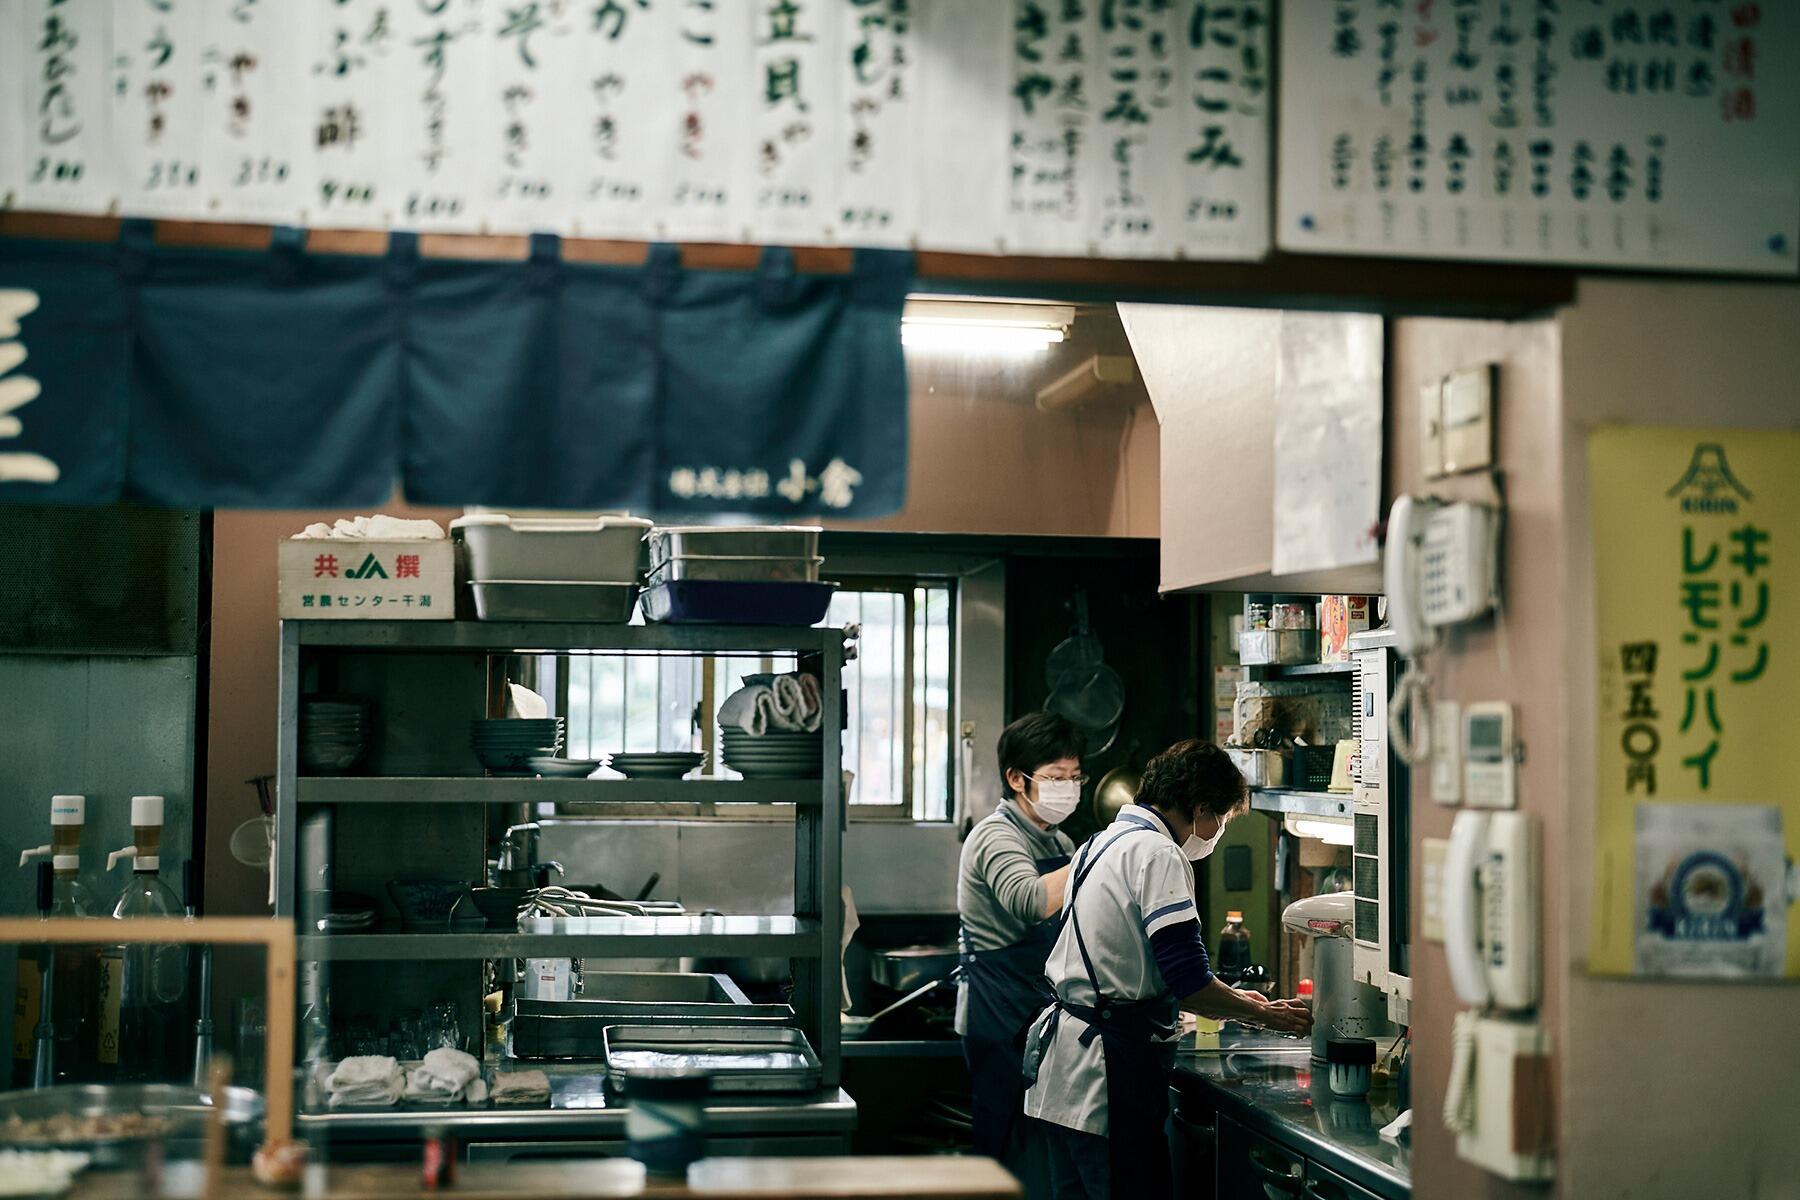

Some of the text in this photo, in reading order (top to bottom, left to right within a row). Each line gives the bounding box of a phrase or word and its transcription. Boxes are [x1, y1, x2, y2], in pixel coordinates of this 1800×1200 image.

[314, 553, 339, 579] 共
[1729, 524, 1771, 684] キリン
[1680, 524, 1723, 791] レモンハイ
